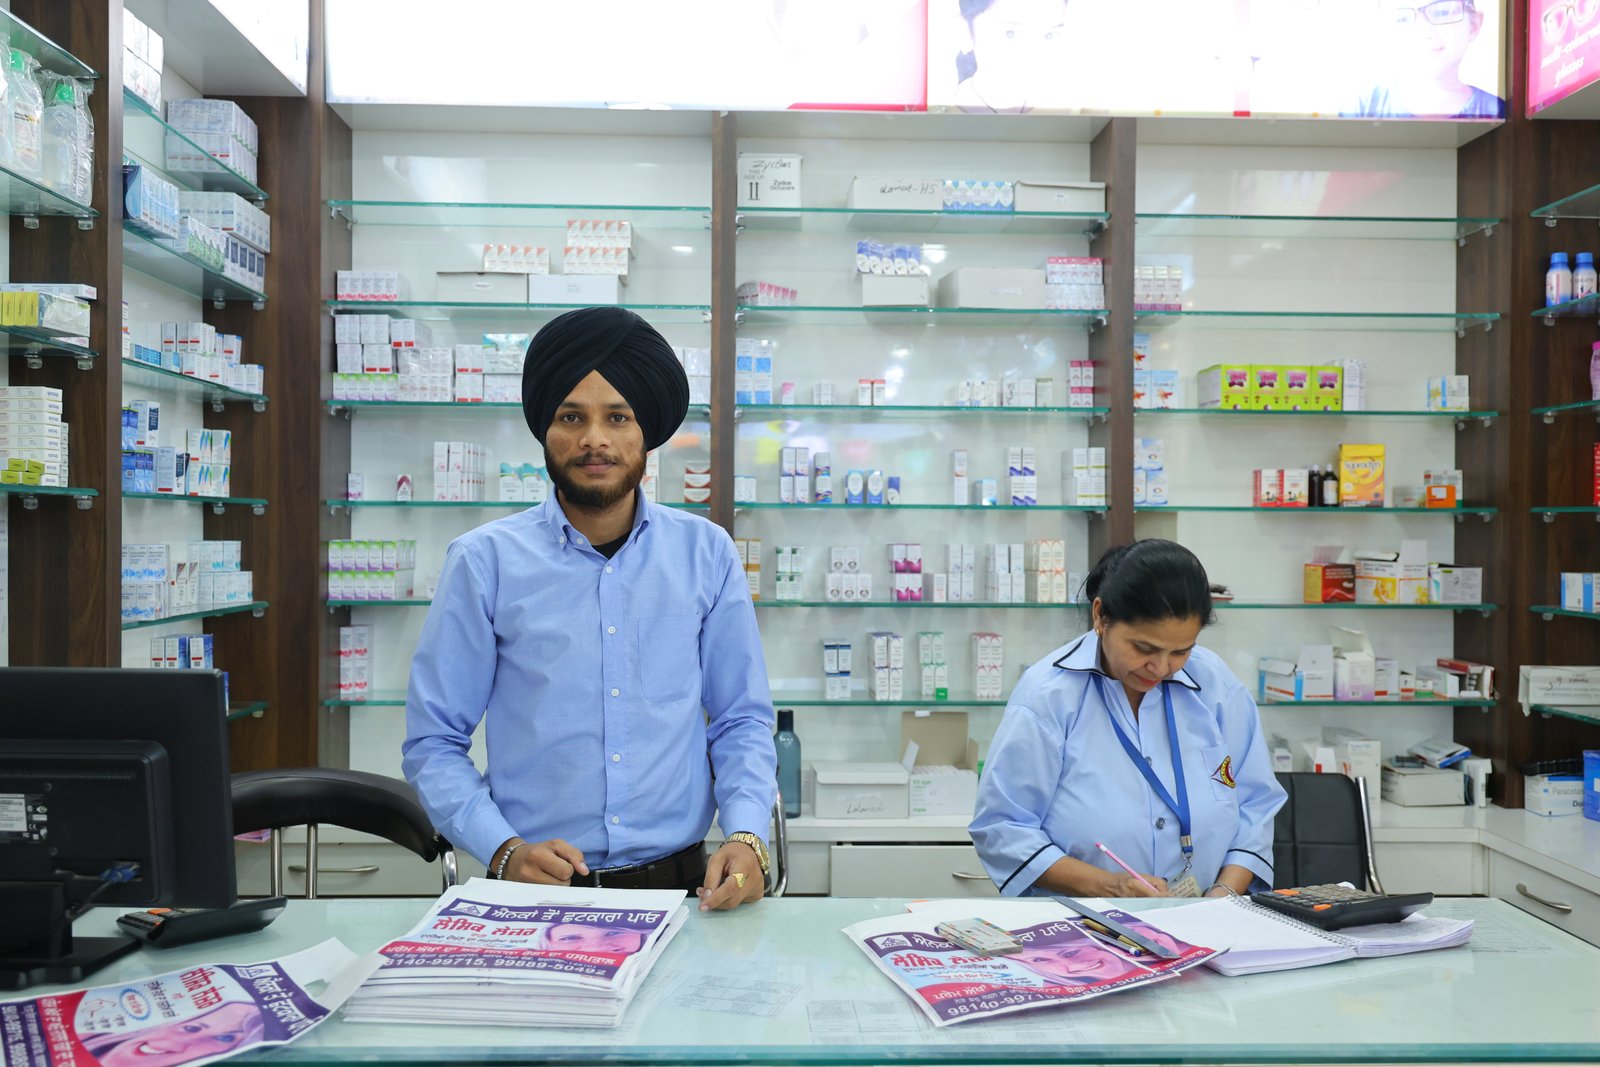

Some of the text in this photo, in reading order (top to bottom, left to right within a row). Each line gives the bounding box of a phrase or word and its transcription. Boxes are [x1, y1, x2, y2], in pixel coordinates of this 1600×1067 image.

[491, 906, 539, 921] ਐਨਕਾਂ
[628, 911, 661, 923] ਪਾਓ
[384, 958, 487, 967] 8140-99715,
[494, 958, 607, 975] 99889-50492
[566, 952, 616, 965] ਹਸਪਤਾਲ
